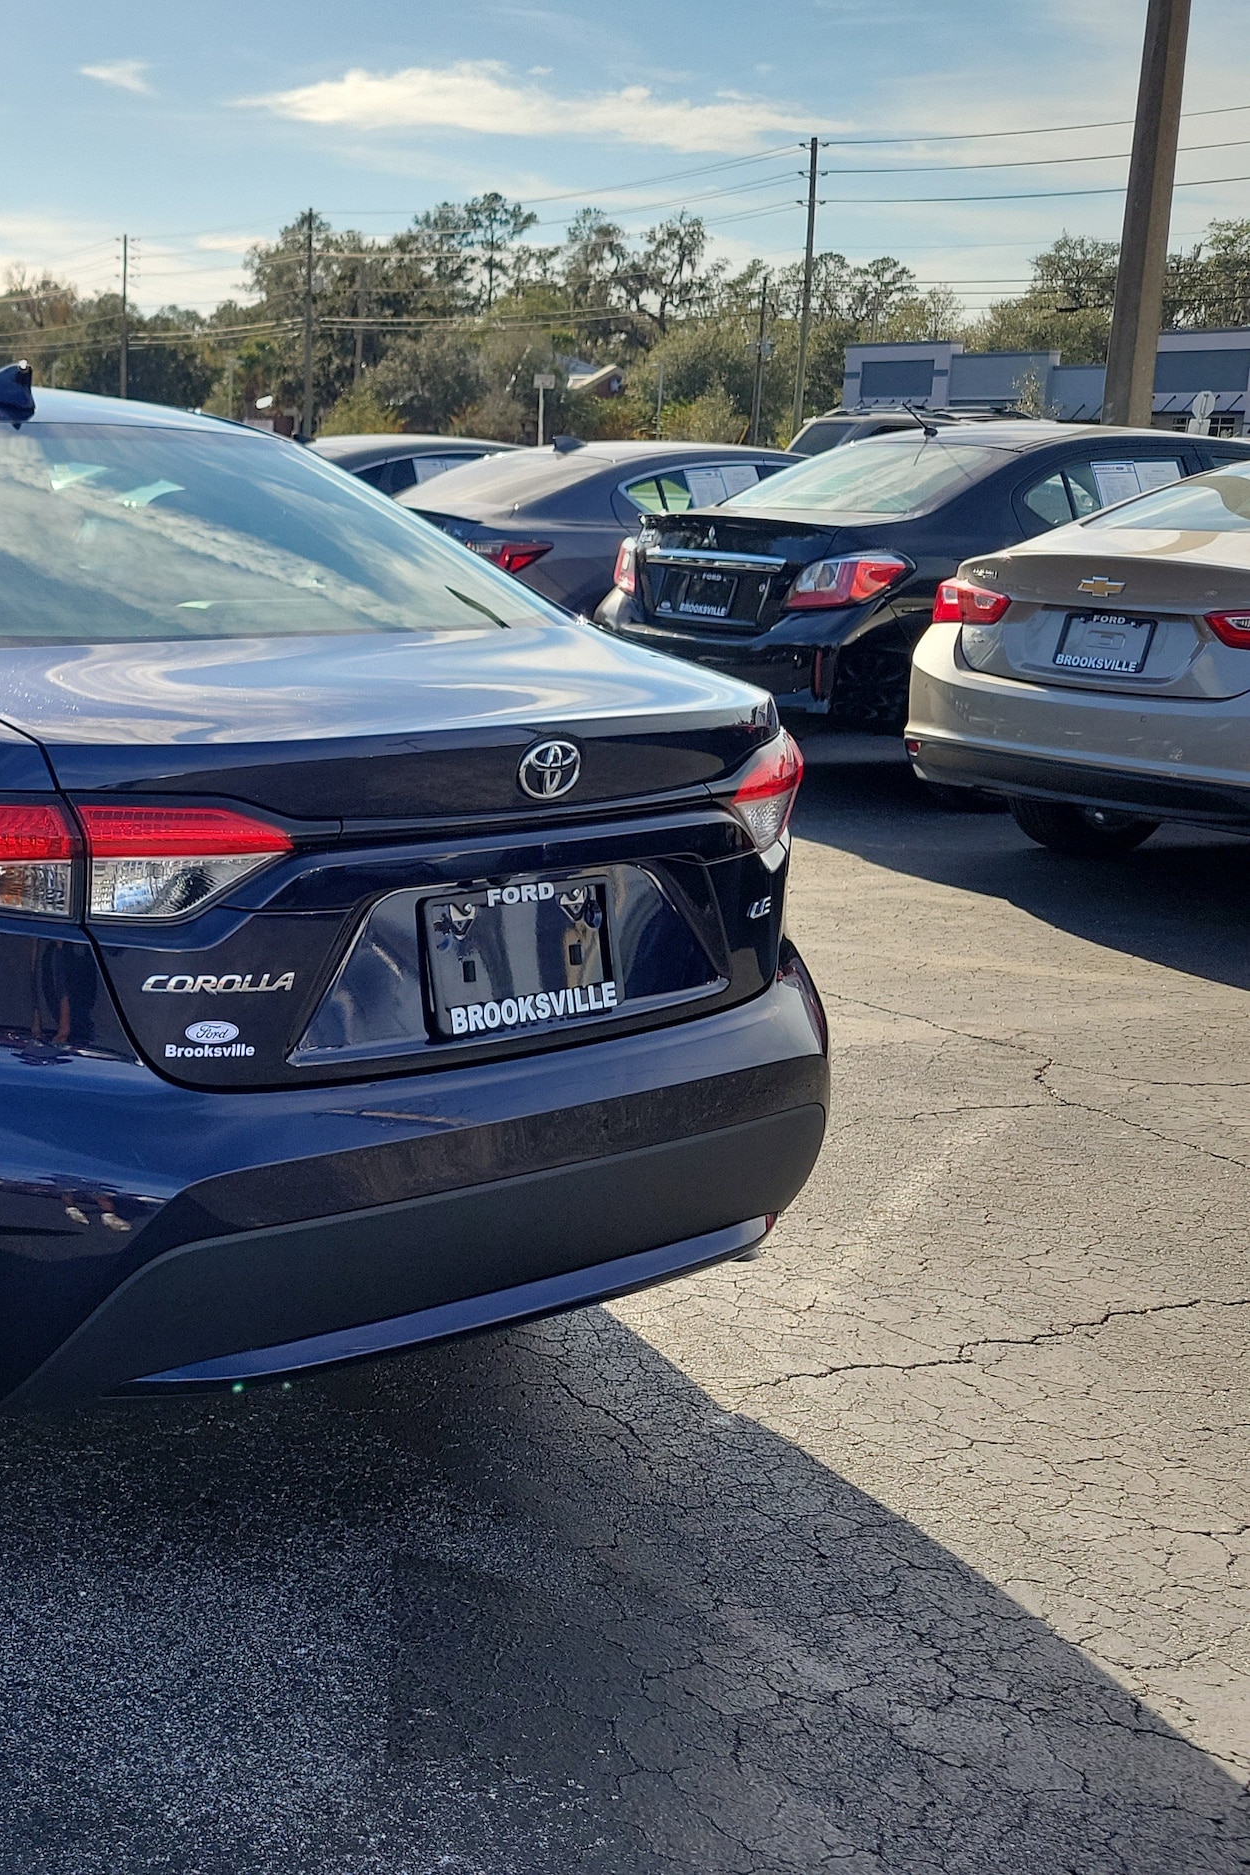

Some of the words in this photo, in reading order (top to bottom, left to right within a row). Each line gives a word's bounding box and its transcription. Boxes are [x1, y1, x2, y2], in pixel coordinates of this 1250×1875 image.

[702, 571, 722, 581] FORD
[679, 602, 727, 617] BROOKSVILLE
[1093, 614, 1126, 625] FORD
[1055, 653, 1138, 673] BROOKSVILLE
[487, 882, 555, 908] FORD
[141, 971, 295, 996] COROLLA
[450, 981, 618, 1035] BROOKSVILLE
[196, 1025, 229, 1040] Ford
[165, 1044, 255, 1058] Brooksville
